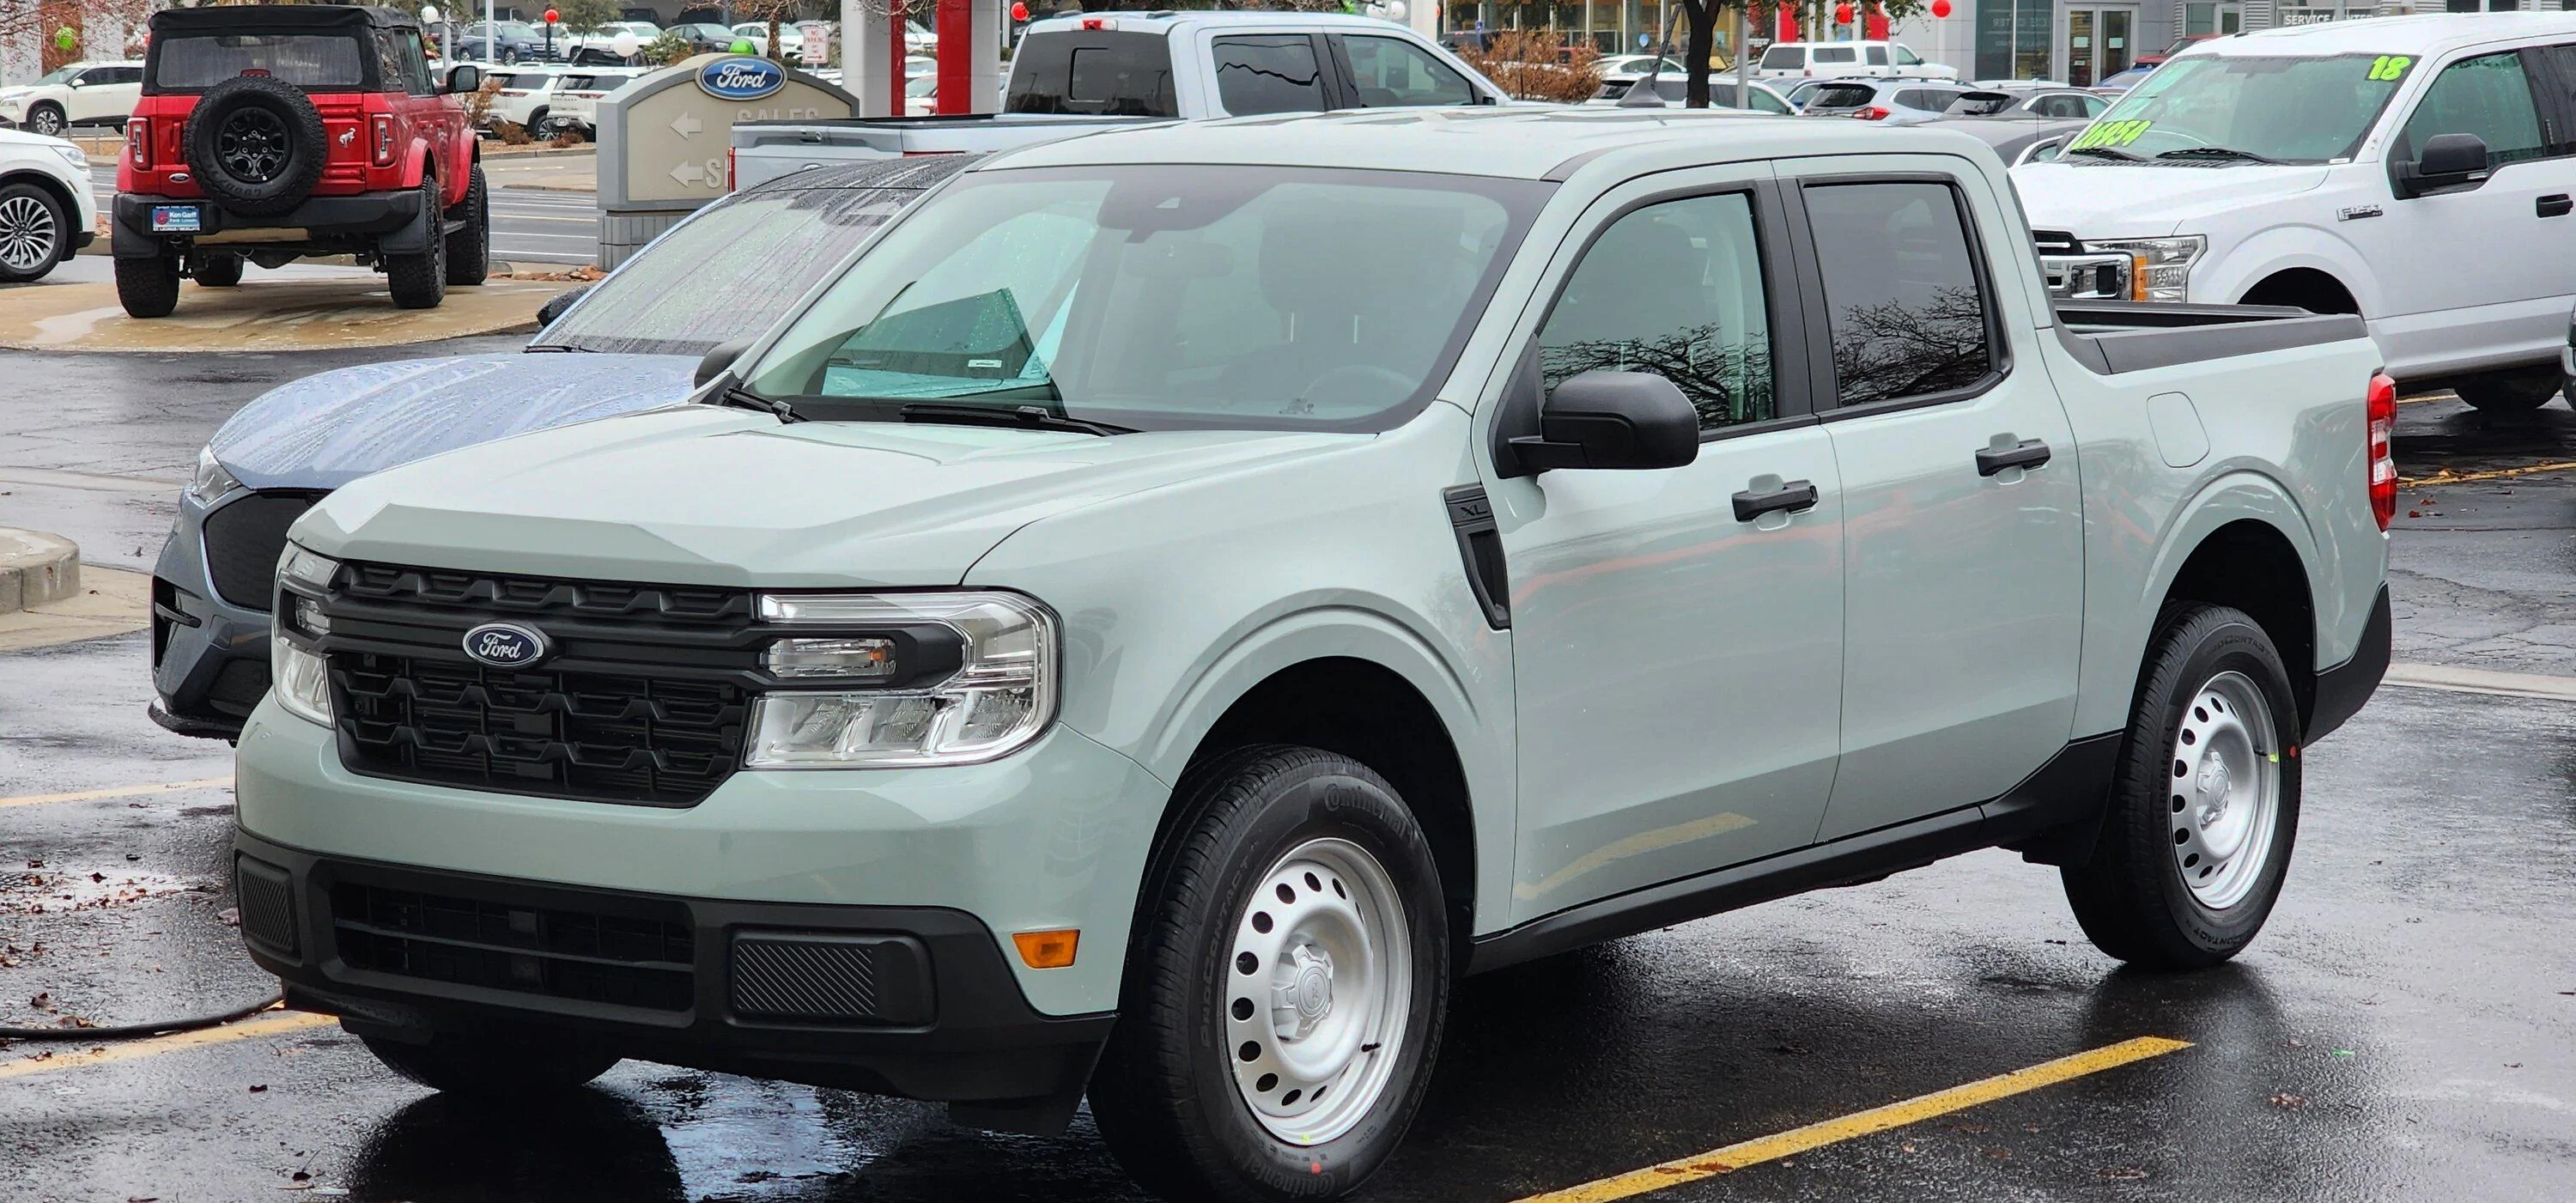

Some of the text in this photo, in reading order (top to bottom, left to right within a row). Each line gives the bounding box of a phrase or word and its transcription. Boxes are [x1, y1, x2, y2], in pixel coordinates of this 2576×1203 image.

[716, 64, 767, 88] Ford
[2368, 55, 2411, 81] 18
[706, 158, 729, 188] S
[1460, 504, 1488, 517] XL
[478, 632, 522, 659] Ford
[1324, 783, 1407, 838] Continental
